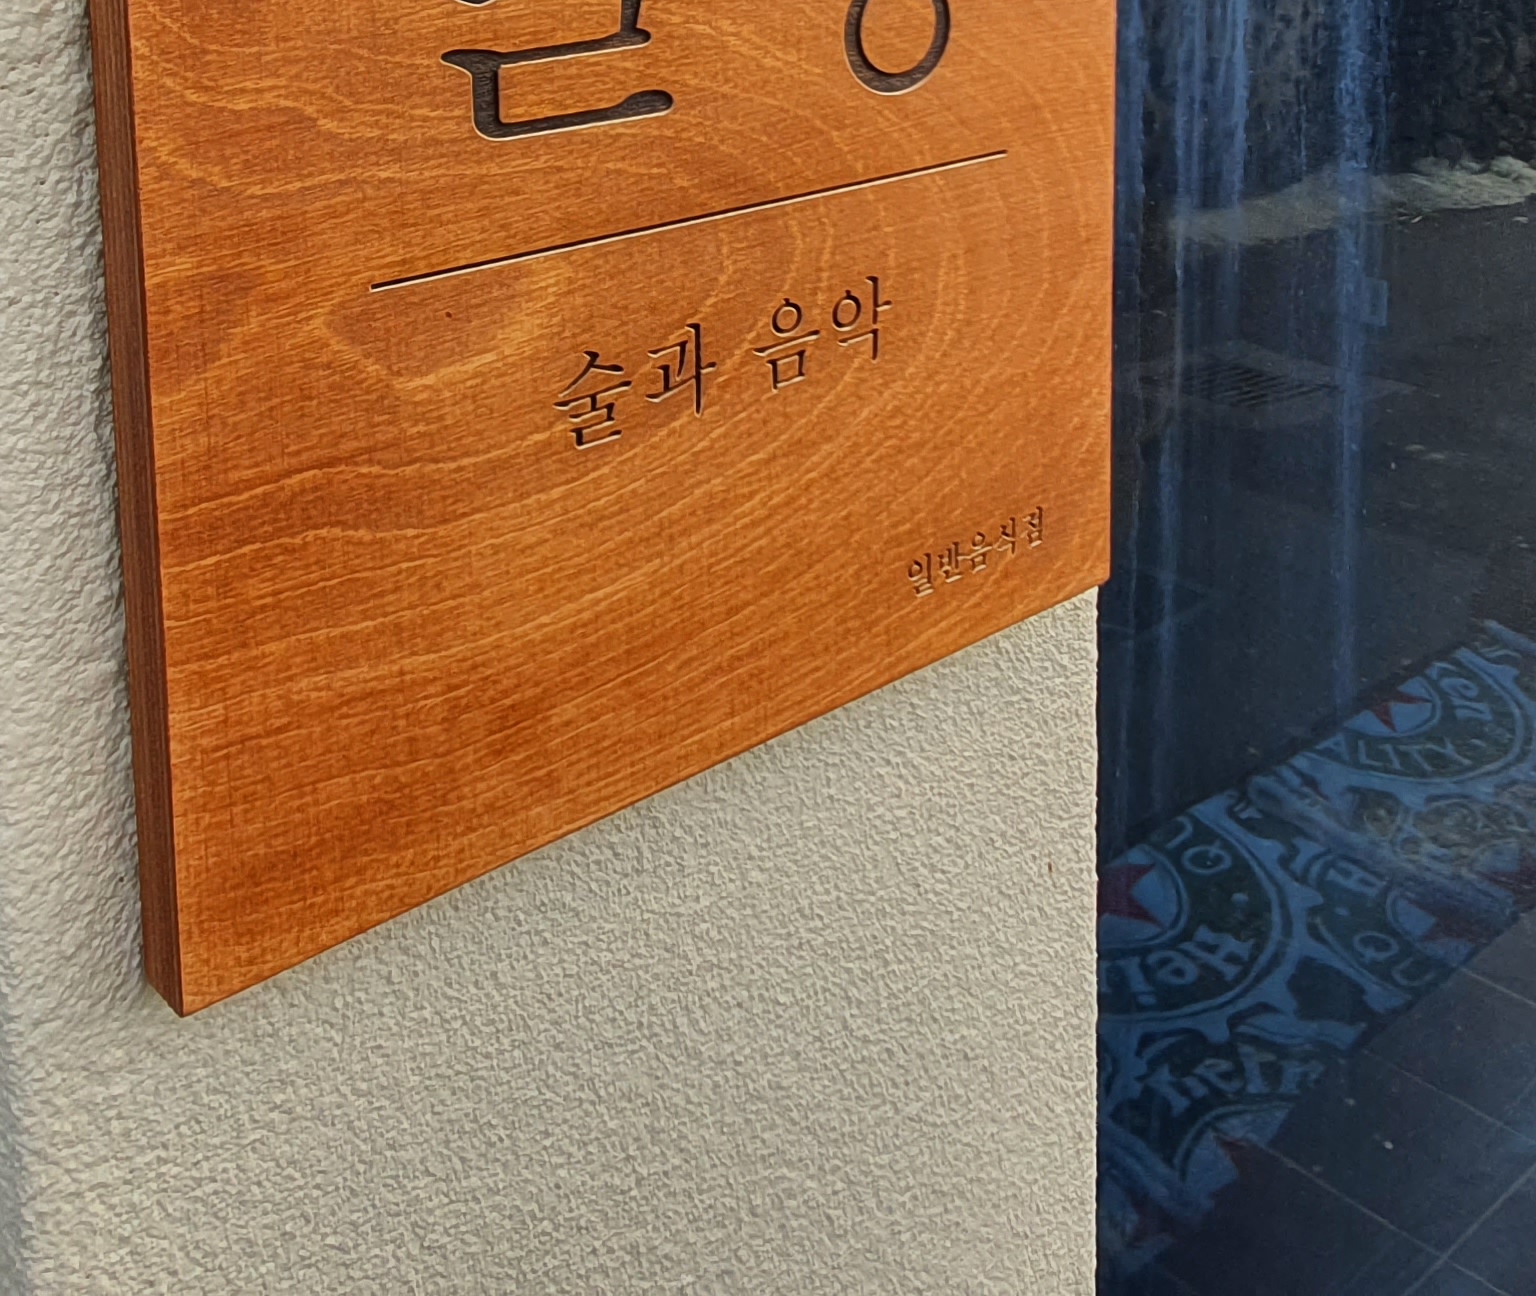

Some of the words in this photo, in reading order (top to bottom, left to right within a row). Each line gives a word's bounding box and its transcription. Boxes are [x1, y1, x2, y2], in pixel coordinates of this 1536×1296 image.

[553, 322, 717, 450] 술과
[753, 275, 893, 394] 음악
[906, 506, 1045, 598] 일반음식점
